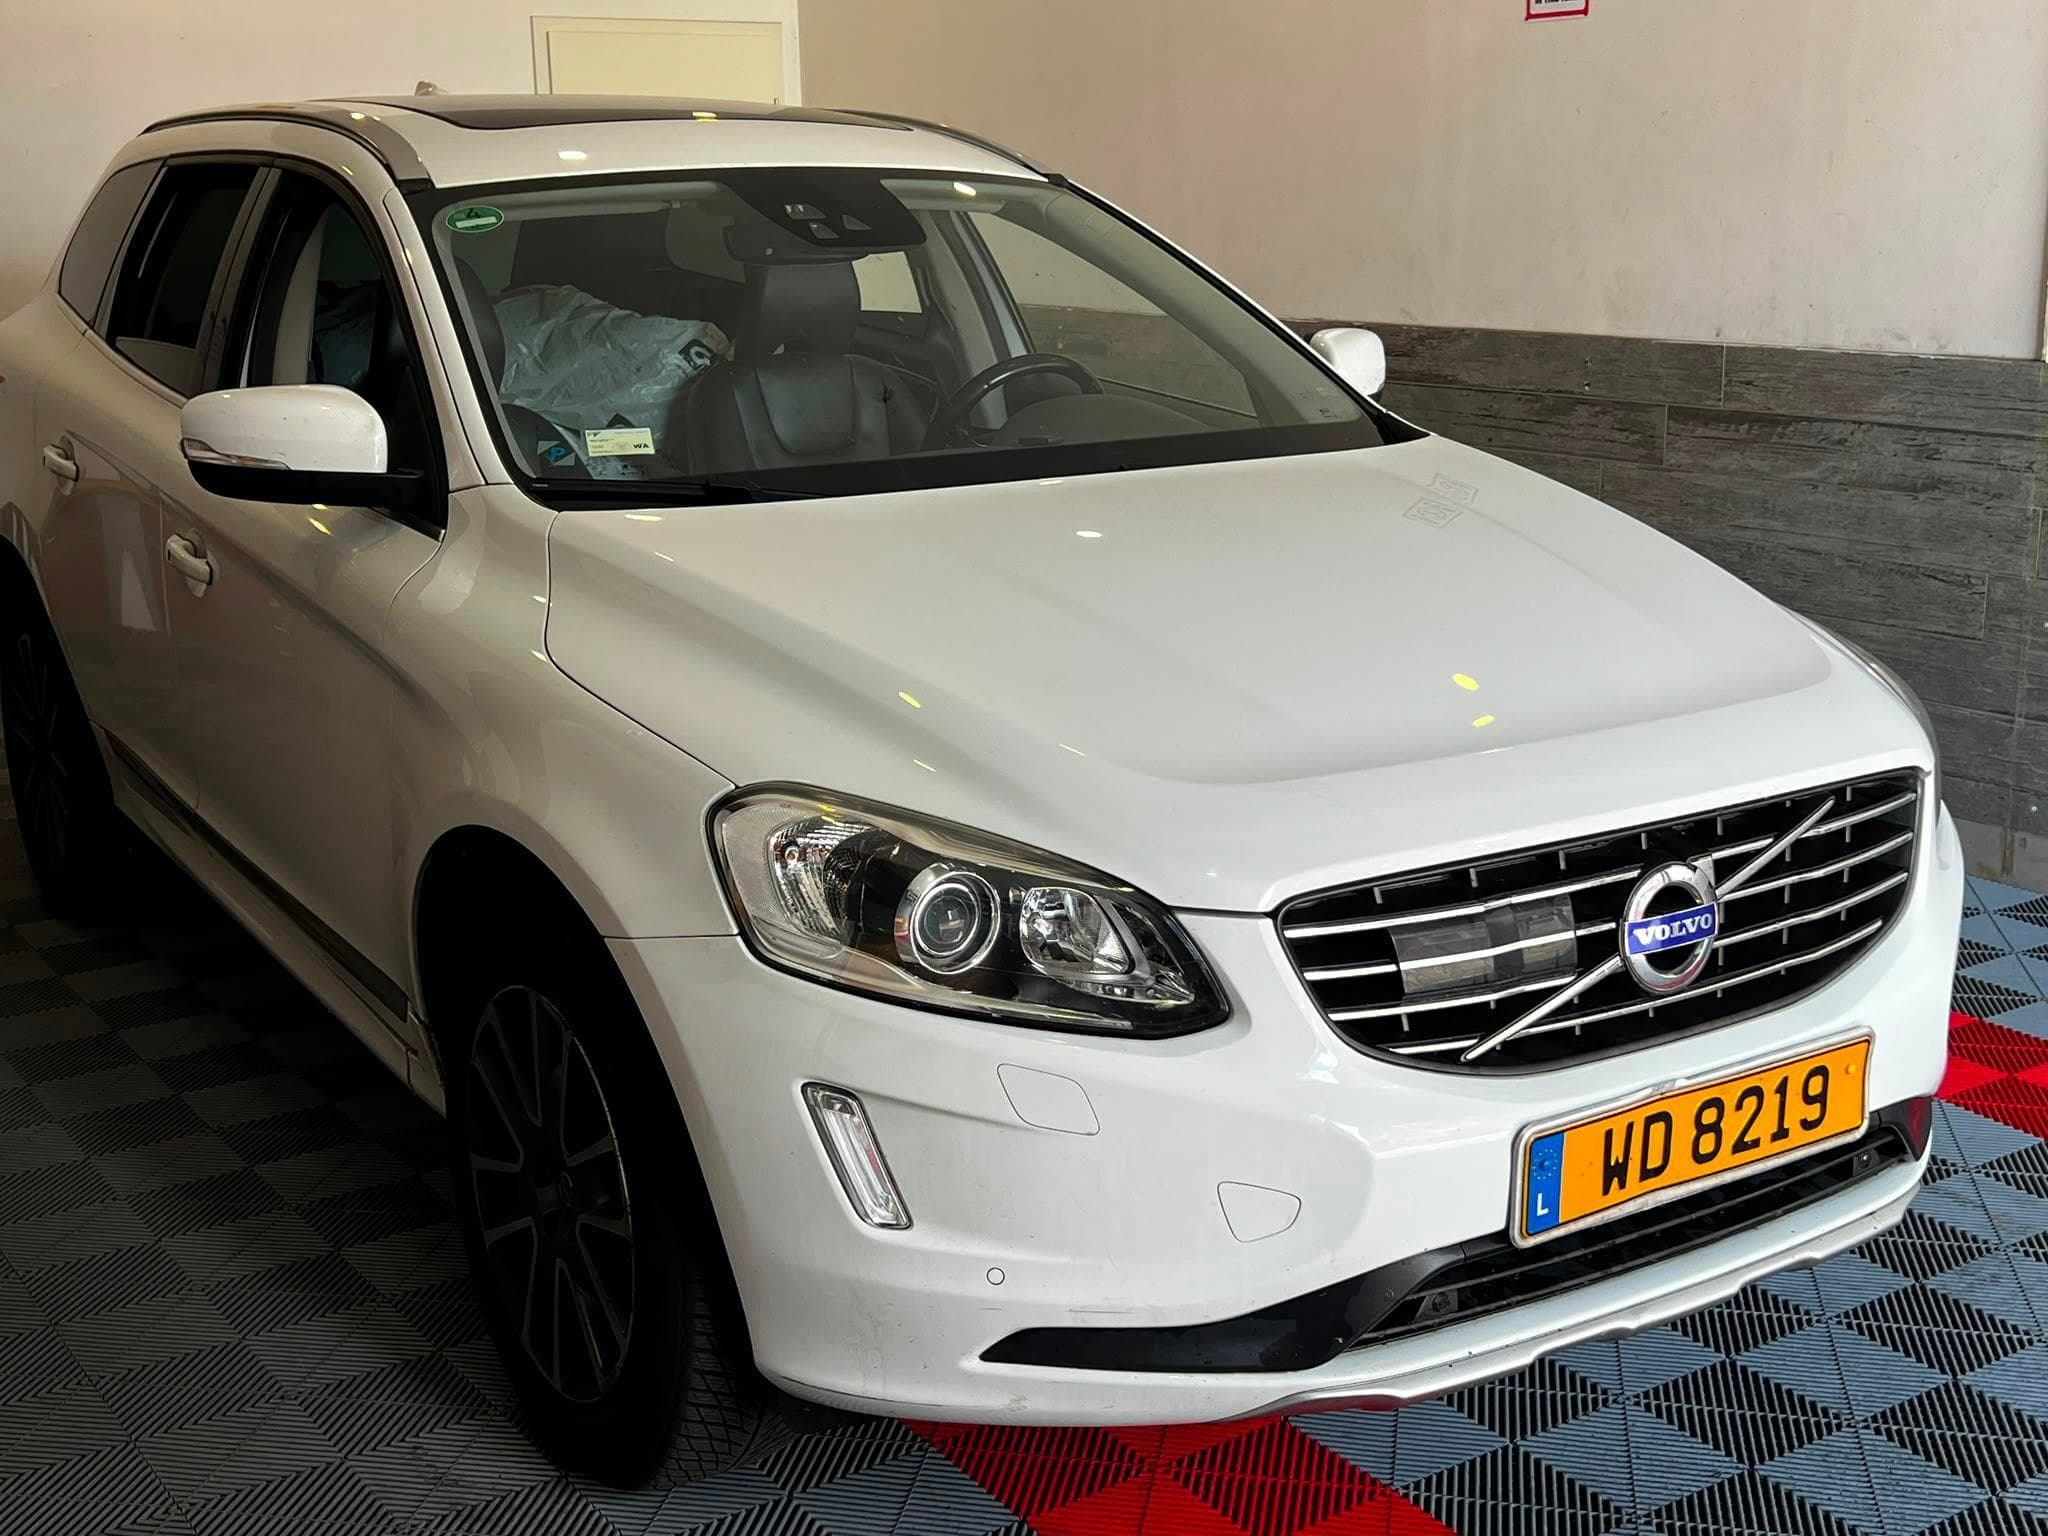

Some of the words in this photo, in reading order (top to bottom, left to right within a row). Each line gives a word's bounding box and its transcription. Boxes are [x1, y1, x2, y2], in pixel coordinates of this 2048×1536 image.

[1632, 913, 1712, 946] VOLVO
[1602, 1111, 1673, 1196] WD
[1691, 1065, 1830, 1165] 8219
[1537, 1193, 1549, 1217] L
